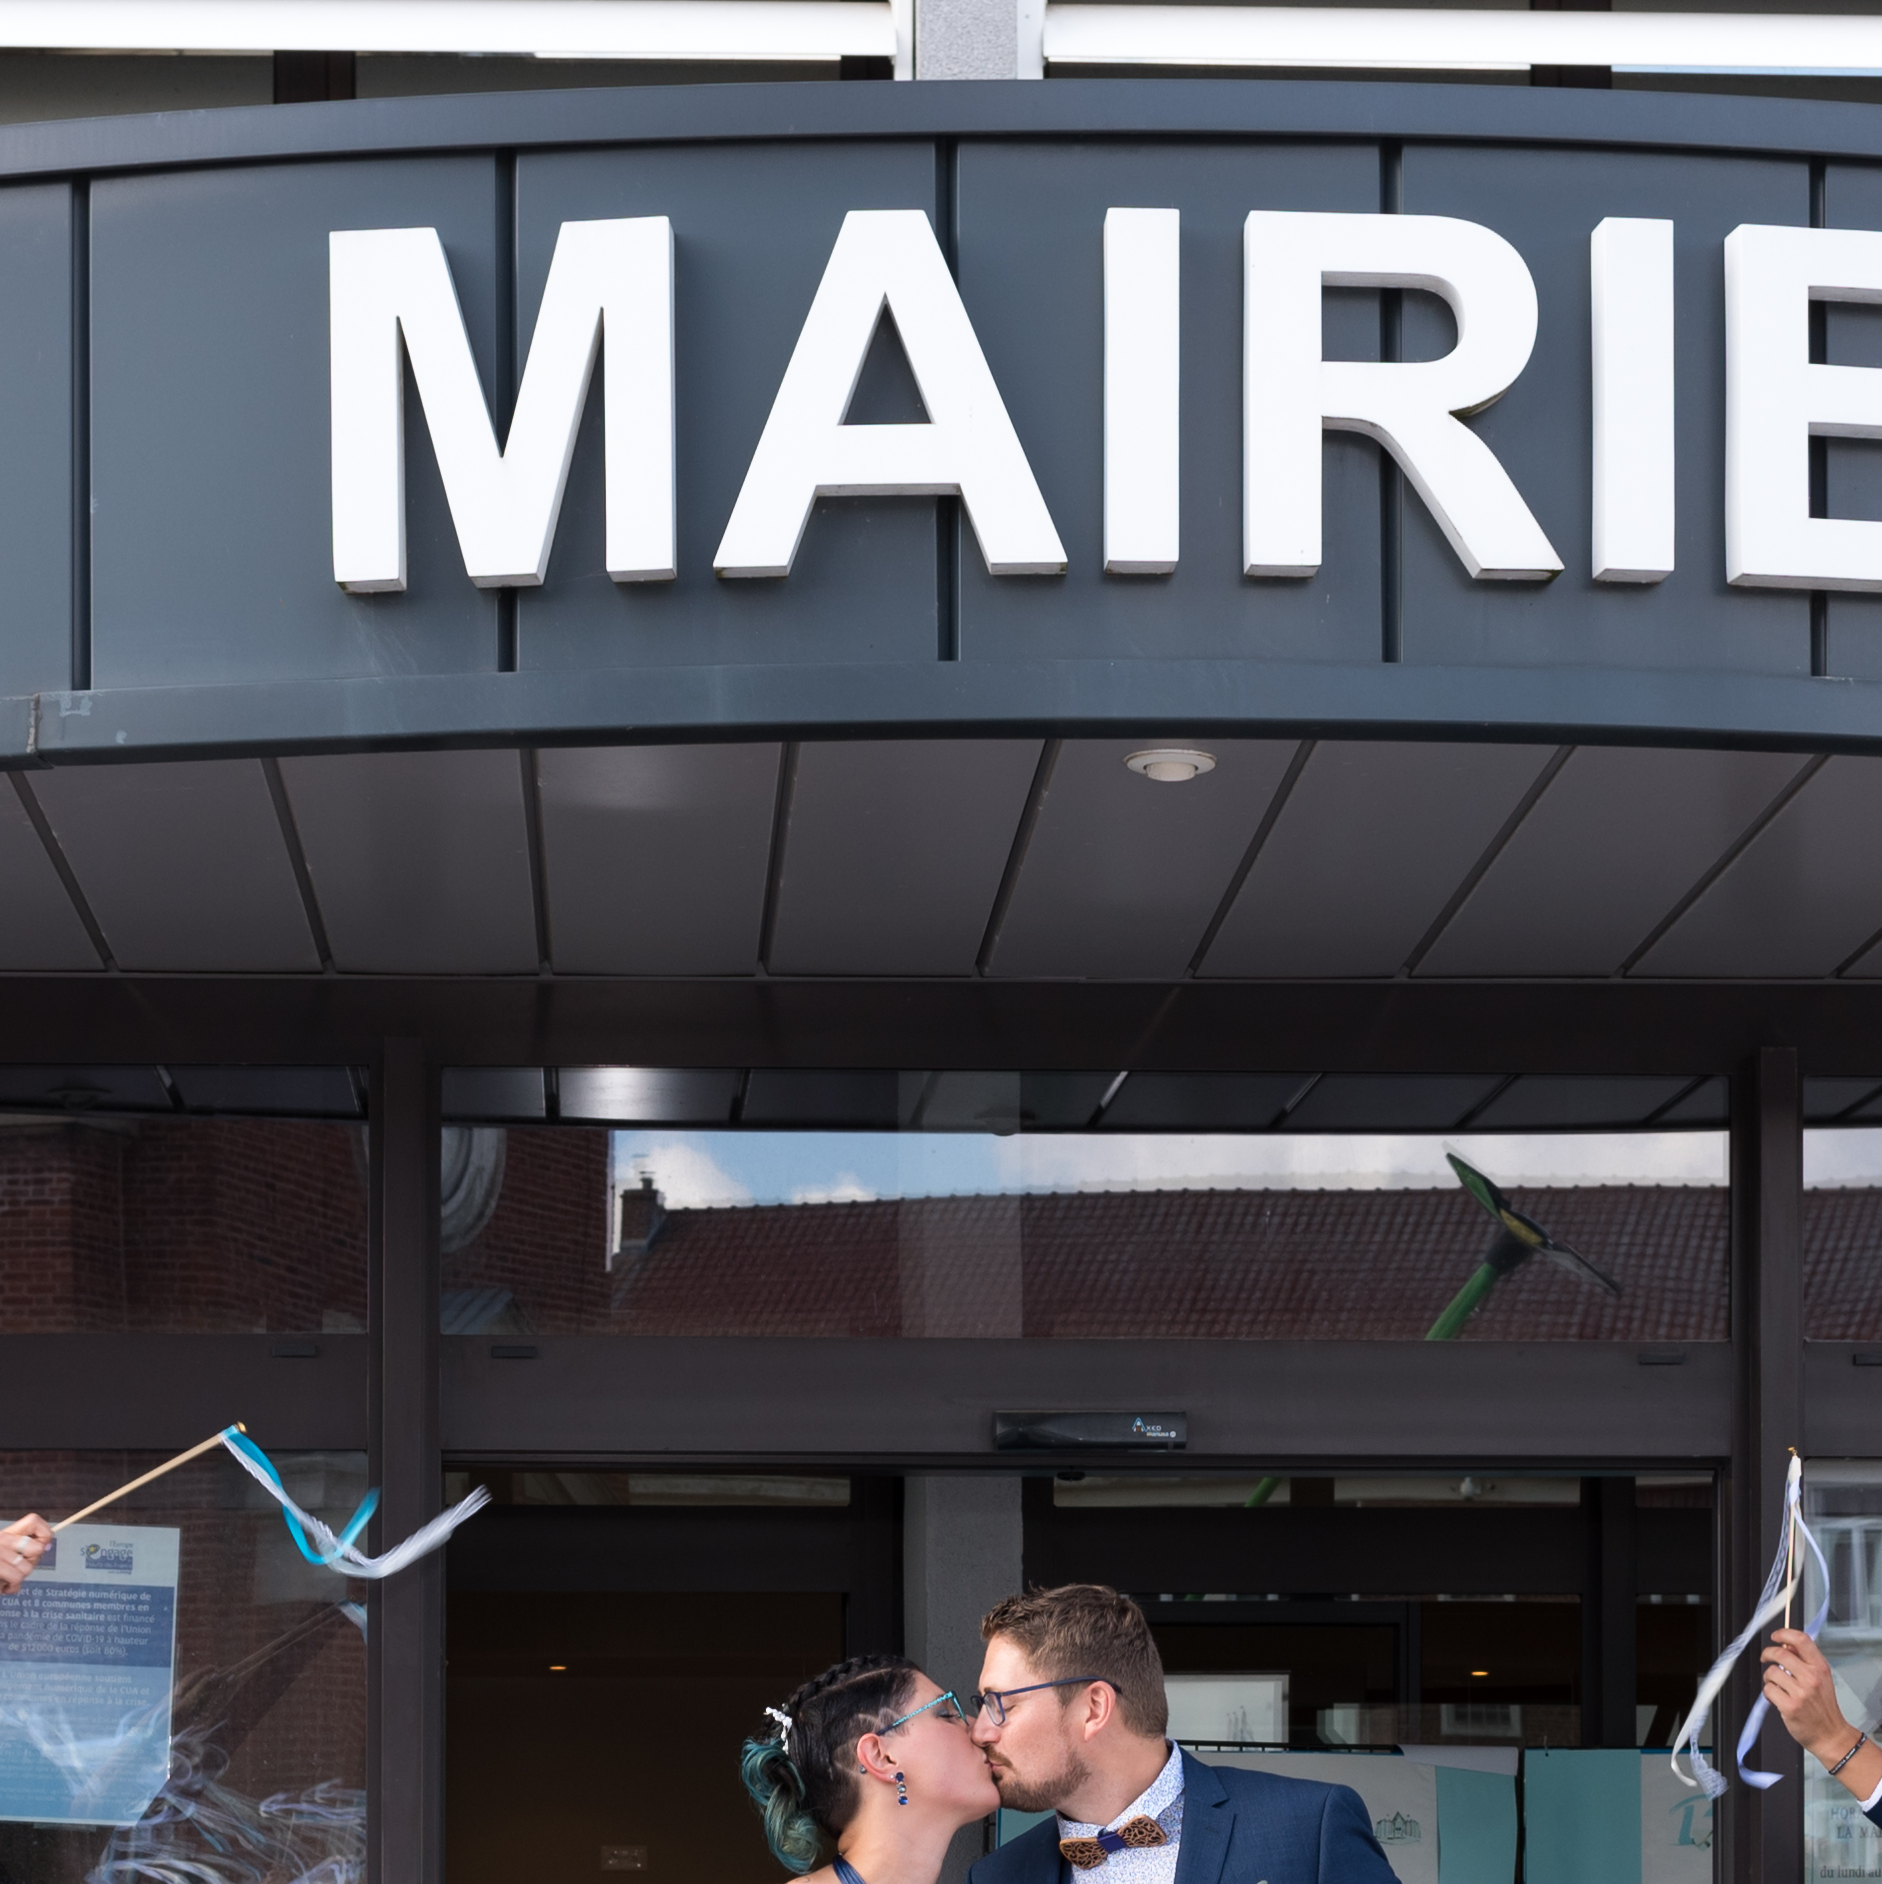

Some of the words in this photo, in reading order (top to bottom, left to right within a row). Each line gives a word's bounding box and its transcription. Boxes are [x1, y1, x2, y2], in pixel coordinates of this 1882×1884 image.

[32, 1588, 43, 1596] de
[45, 1587, 87, 1599] Stratégie
[89, 1590, 138, 1602] numérique
[140, 1592, 152, 1600] de
[2, 1598, 20, 1606] CUA
[33, 1599, 40, 1607] 8
[41, 1601, 92, 1609] communes
[93, 1600, 136, 1610] membres
[23, 1608, 29, 1617] à
[31, 1609, 39, 1618] la
[41, 1610, 64, 1619] crise
[65, 1611, 105, 1621] sanitaire
[107, 1614, 121, 1622] est
[122, 1613, 155, 1623] financé
[10, 1620, 19, 1629] le
[20, 1620, 45, 1630] cadre
[46, 1622, 58, 1630] de
[60, 1623, 68, 1631] la
[70, 1623, 106, 1633] réponse
[107, 1625, 119, 1633] de
[121, 1625, 152, 1635] l'Union
[52, 1632, 64, 1642] de
[65, 1634, 105, 1643] COVID-19
[119, 1686, 139, 1695] CUA
[1837, 1827, 1853, 1839] LA
[1820, 1865, 1834, 1878] du
[1837, 1865, 1866, 1878] lundi
[1868, 1867, 1882, 1878] au
